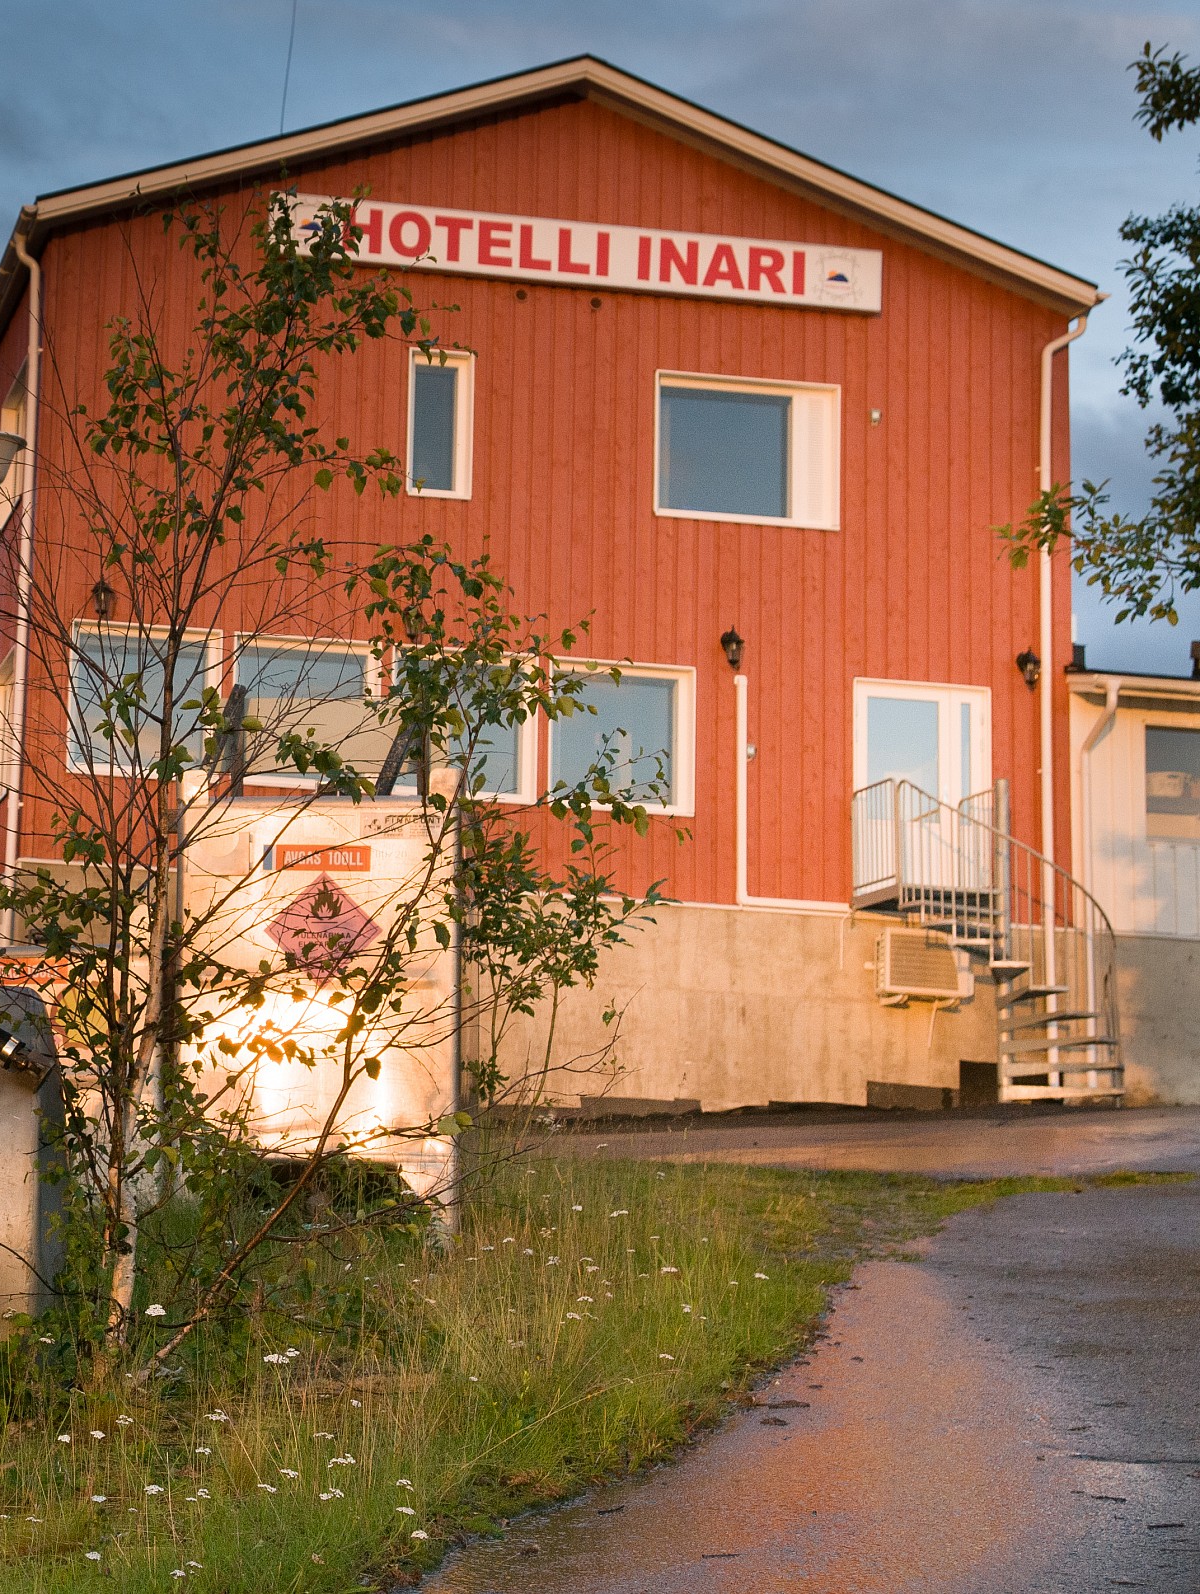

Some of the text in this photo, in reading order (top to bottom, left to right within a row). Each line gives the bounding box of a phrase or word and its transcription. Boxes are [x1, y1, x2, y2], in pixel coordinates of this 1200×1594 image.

[342, 206, 806, 296] HOTELLI INARI
[284, 850, 322, 866] AVGAS
[328, 851, 364, 867] 100LL
